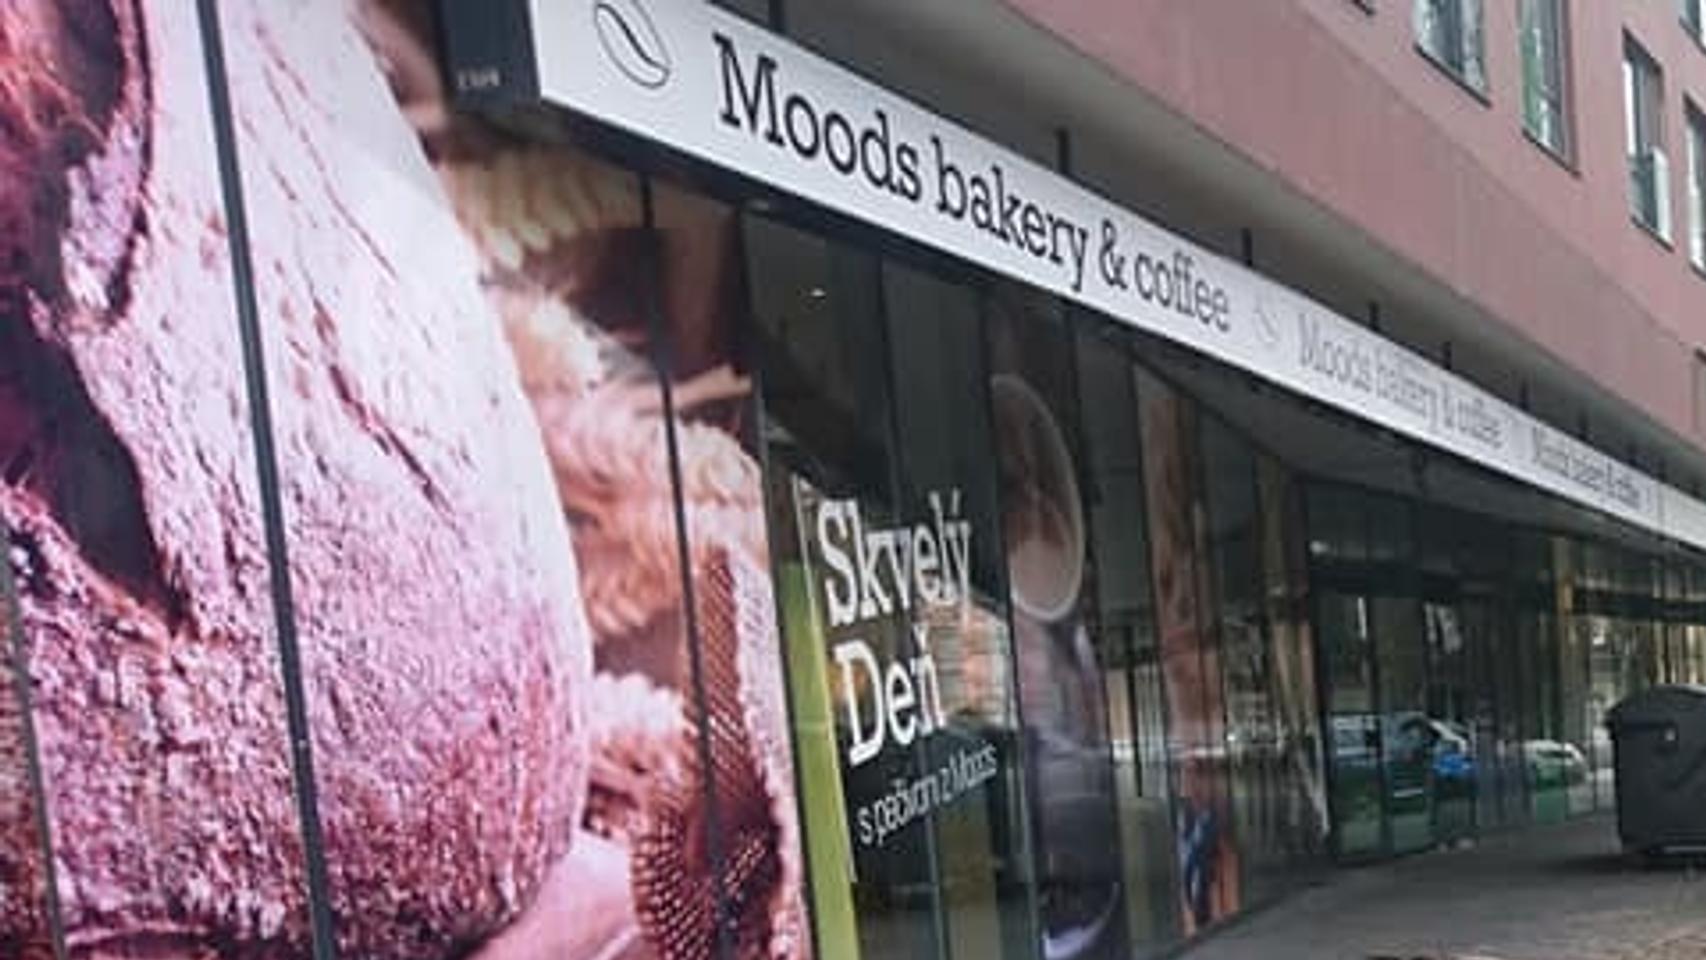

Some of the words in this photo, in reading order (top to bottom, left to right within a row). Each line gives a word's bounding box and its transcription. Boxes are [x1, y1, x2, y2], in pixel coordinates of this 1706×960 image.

[712, 30, 922, 202] Moods
[931, 133, 1088, 293] bakery
[1099, 217, 1128, 290] &
[1134, 250, 1230, 332] coffee
[817, 487, 972, 634] Skvelý
[833, 620, 947, 767] Deň
